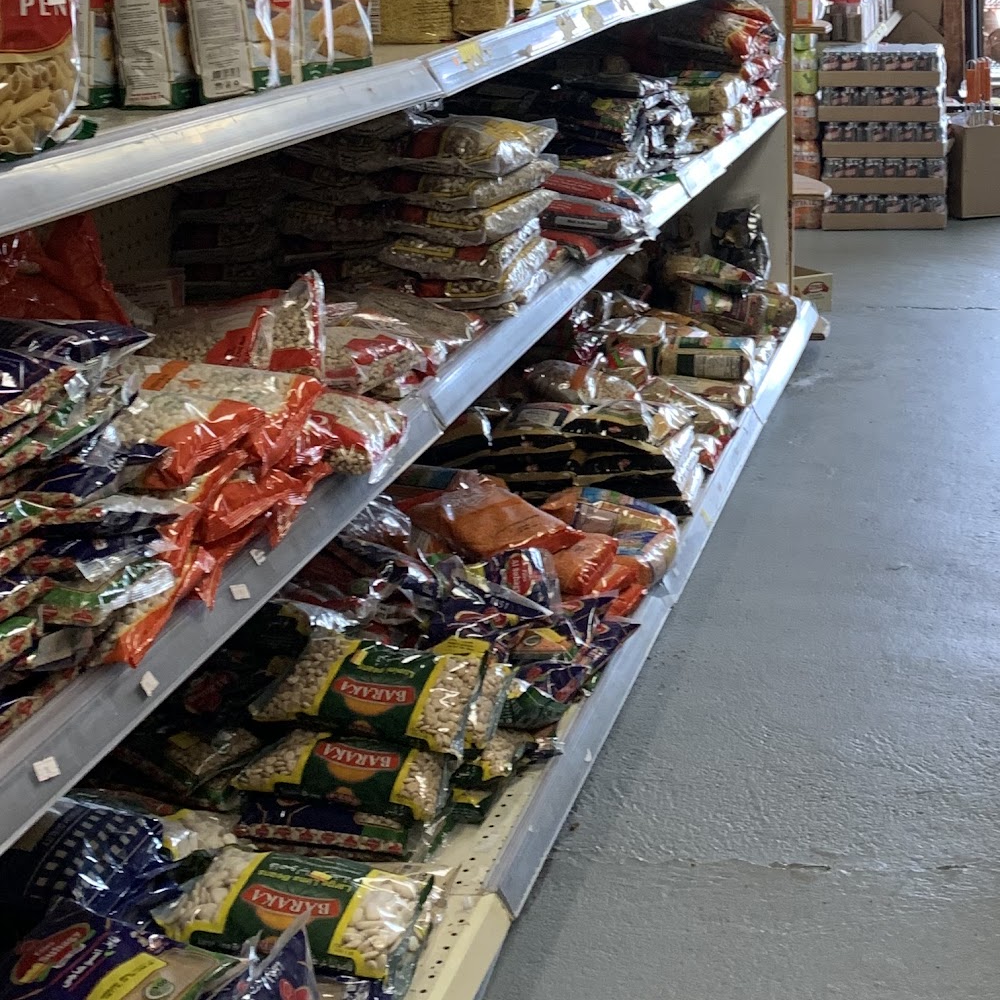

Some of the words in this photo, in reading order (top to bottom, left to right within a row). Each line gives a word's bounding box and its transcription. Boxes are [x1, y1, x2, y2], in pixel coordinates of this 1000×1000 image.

[339, 680, 407, 703] BARAKA
[322, 742, 393, 768] BARAKA
[251, 889, 331, 915] BARAKA
